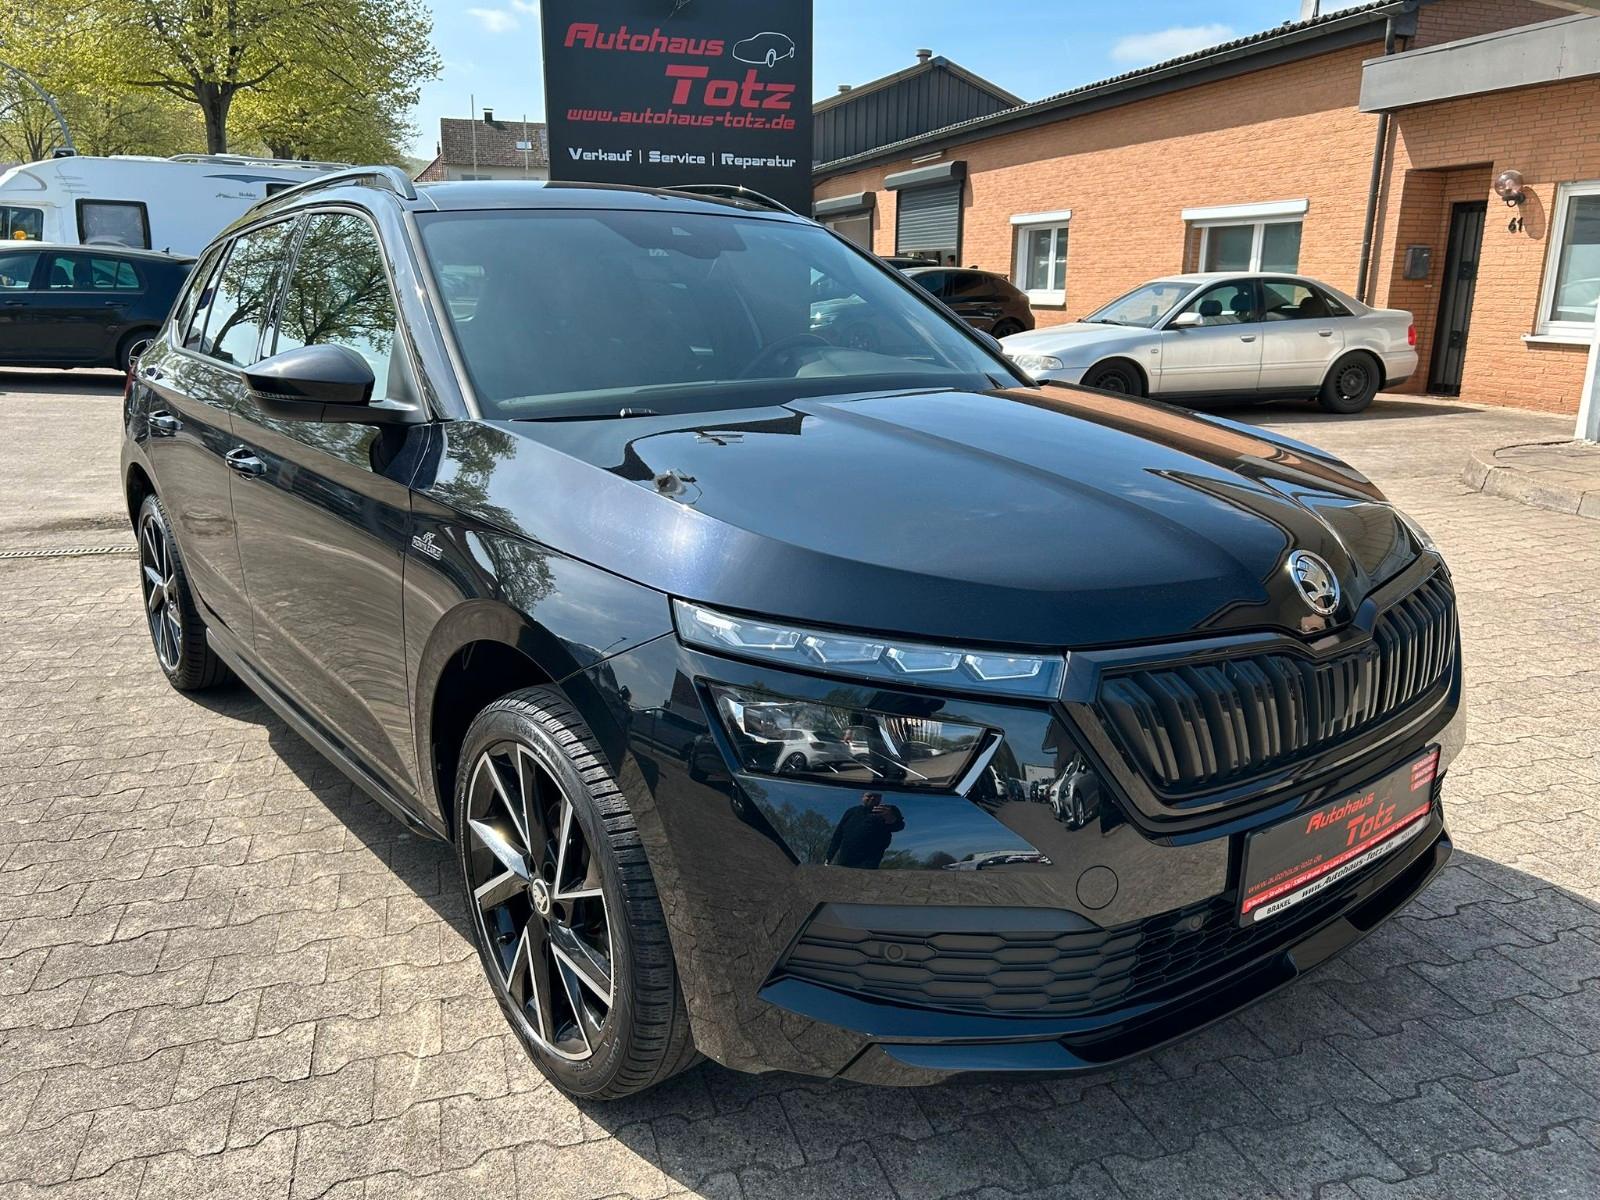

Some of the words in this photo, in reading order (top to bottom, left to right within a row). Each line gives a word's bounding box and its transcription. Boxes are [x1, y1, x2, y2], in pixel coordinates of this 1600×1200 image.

[564, 22, 725, 57] Autohaus
[665, 64, 796, 110] Totz
[567, 107, 796, 130] www.autohaus-totz.de
[568, 147, 633, 163] Verkauf
[648, 150, 706, 165] Service
[721, 152, 796, 169] Reparatur
[1508, 217, 1523, 234] 61
[1305, 792, 1375, 834] Autohaus
[1346, 802, 1396, 846] Totz
[1266, 899, 1291, 915] BRAKEL
